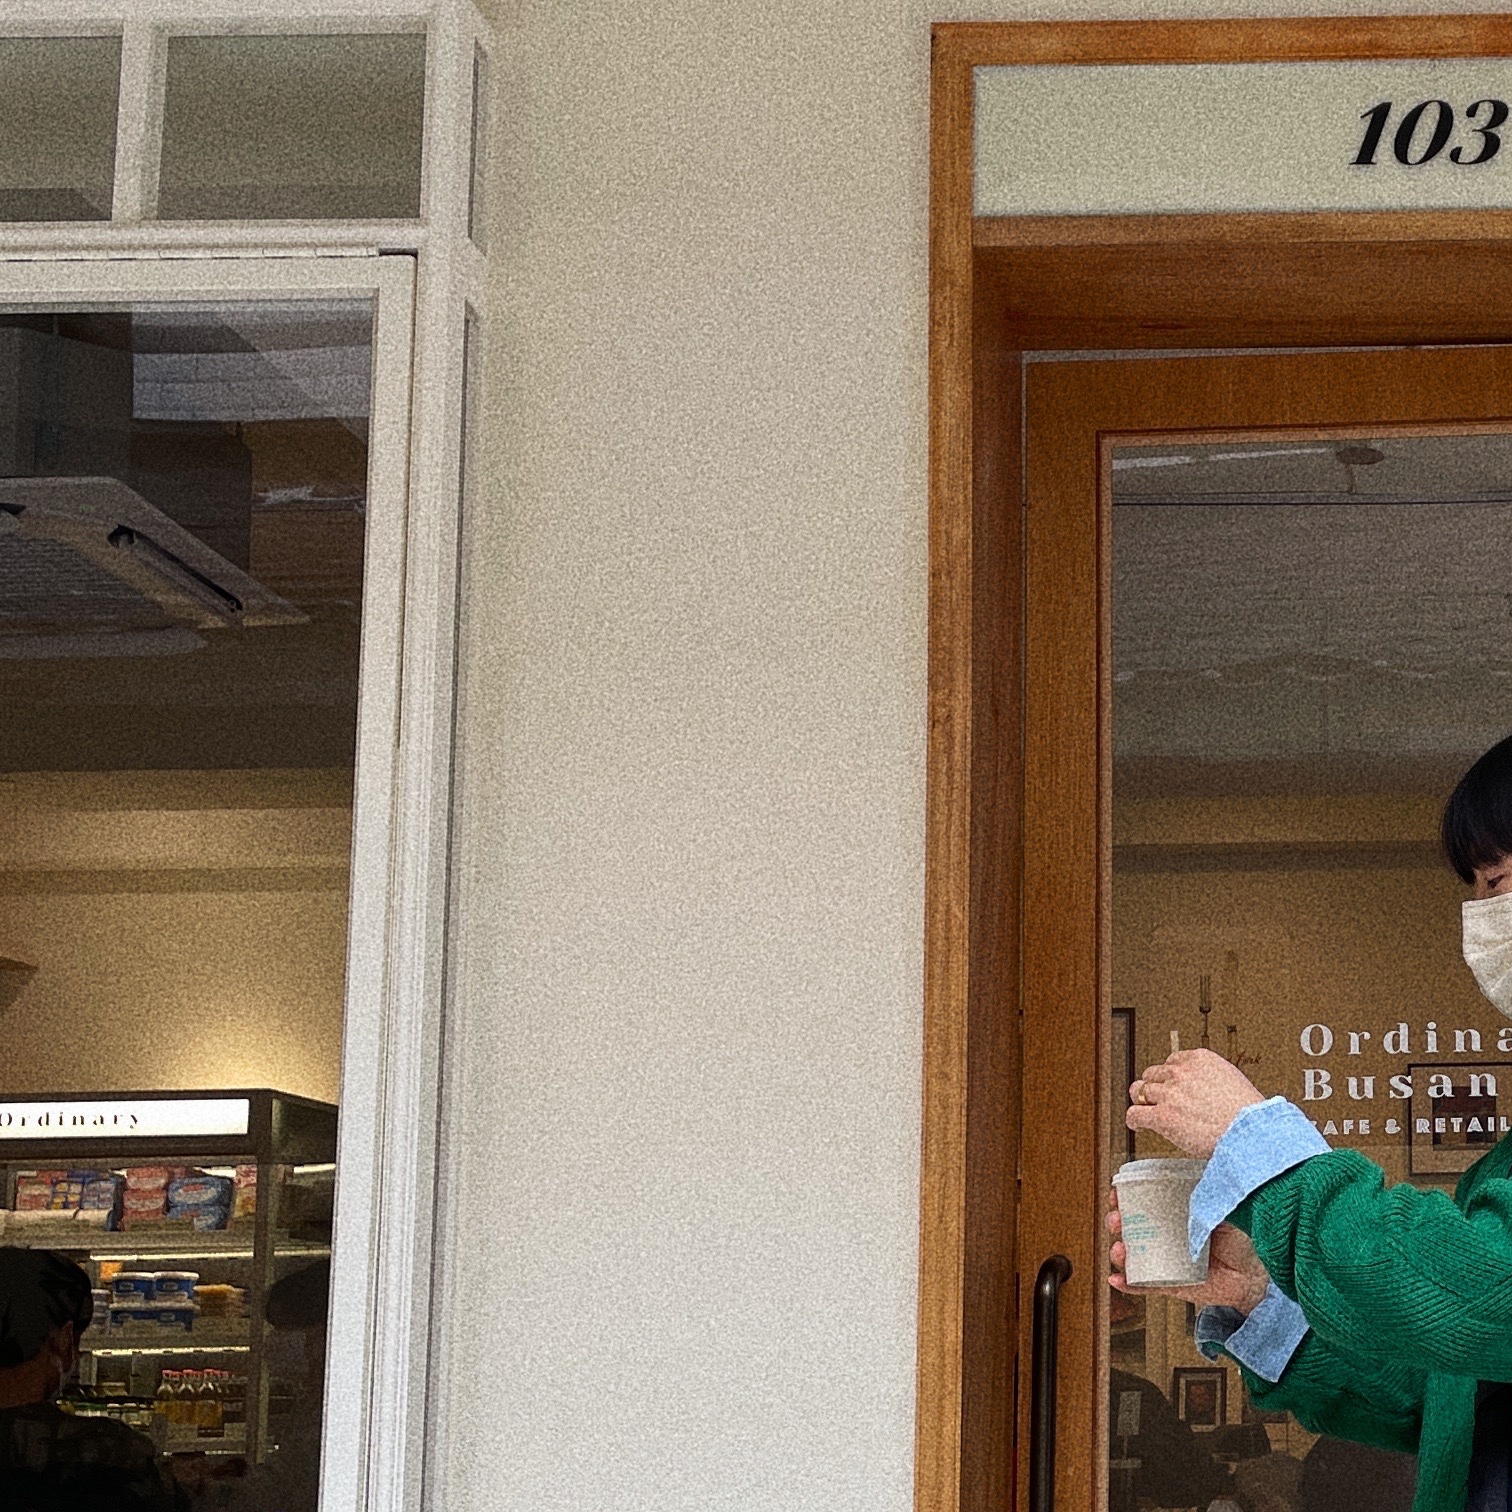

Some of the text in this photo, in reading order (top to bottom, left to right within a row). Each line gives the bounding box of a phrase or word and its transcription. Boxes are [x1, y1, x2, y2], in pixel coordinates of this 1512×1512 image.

[1349, 99, 1509, 165] 103
[1302, 1069, 1499, 1100] Busan
[0, 1111, 138, 1129] Ordinary
[1311, 1116, 1511, 1135] AFE & RETAIL
